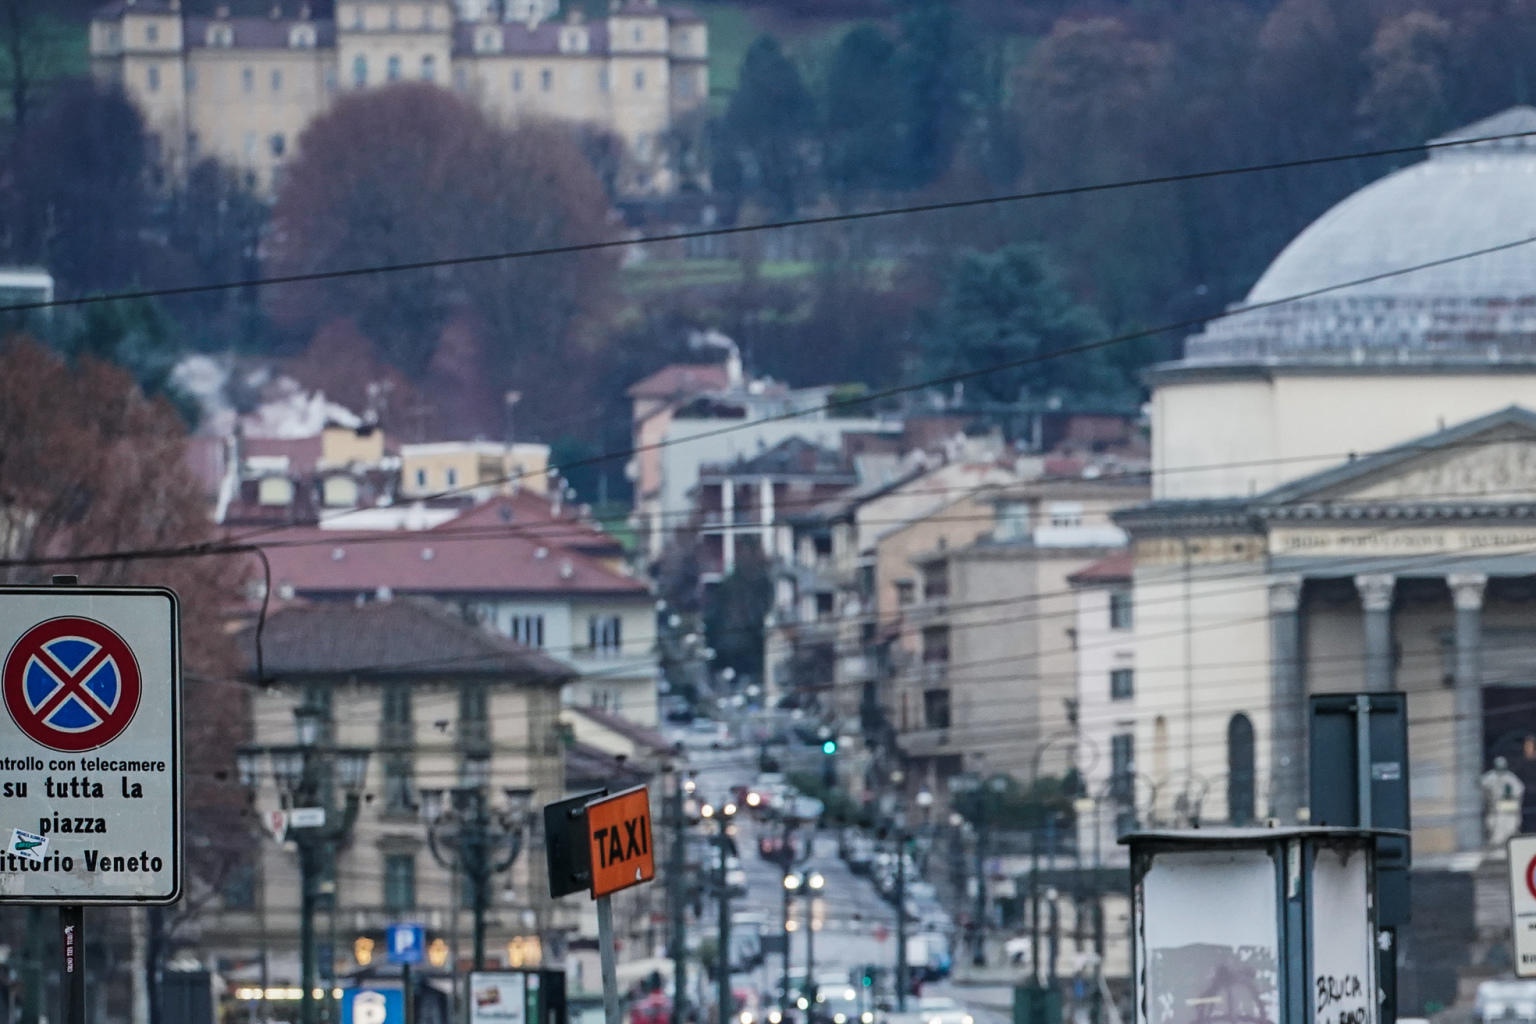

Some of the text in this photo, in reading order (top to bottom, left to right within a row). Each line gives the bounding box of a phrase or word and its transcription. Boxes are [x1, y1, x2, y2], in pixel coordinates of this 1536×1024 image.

[49, 760, 76, 771] con
[81, 757, 166, 772] telecamere
[3, 776, 144, 798] su tutta la
[39, 811, 107, 836] piazza
[593, 815, 648, 869] TAXI
[84, 849, 163, 873] Veneto
